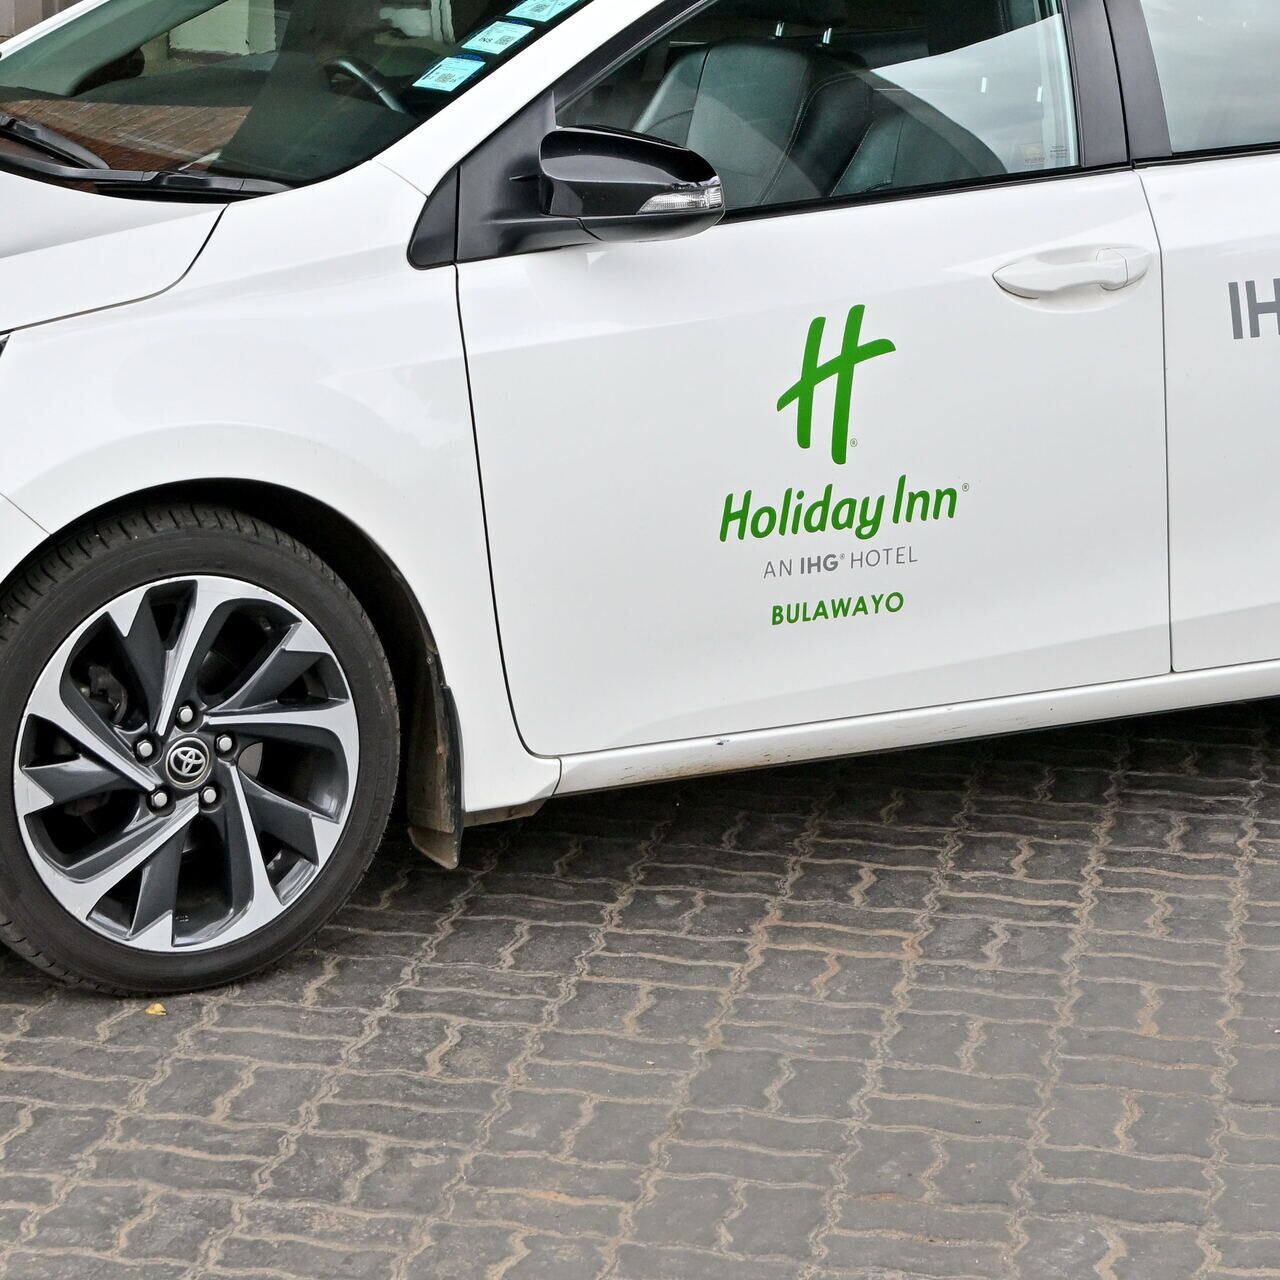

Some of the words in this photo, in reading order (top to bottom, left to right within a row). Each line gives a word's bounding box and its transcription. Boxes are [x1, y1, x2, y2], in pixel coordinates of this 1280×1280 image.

[719, 483, 886, 543] Holiday
[891, 474, 958, 524] Inn
[763, 559, 793, 580] AN
[799, 553, 840, 575] IHG
[850, 546, 919, 569] HOTEL
[771, 591, 904, 626] BULAWAYO
